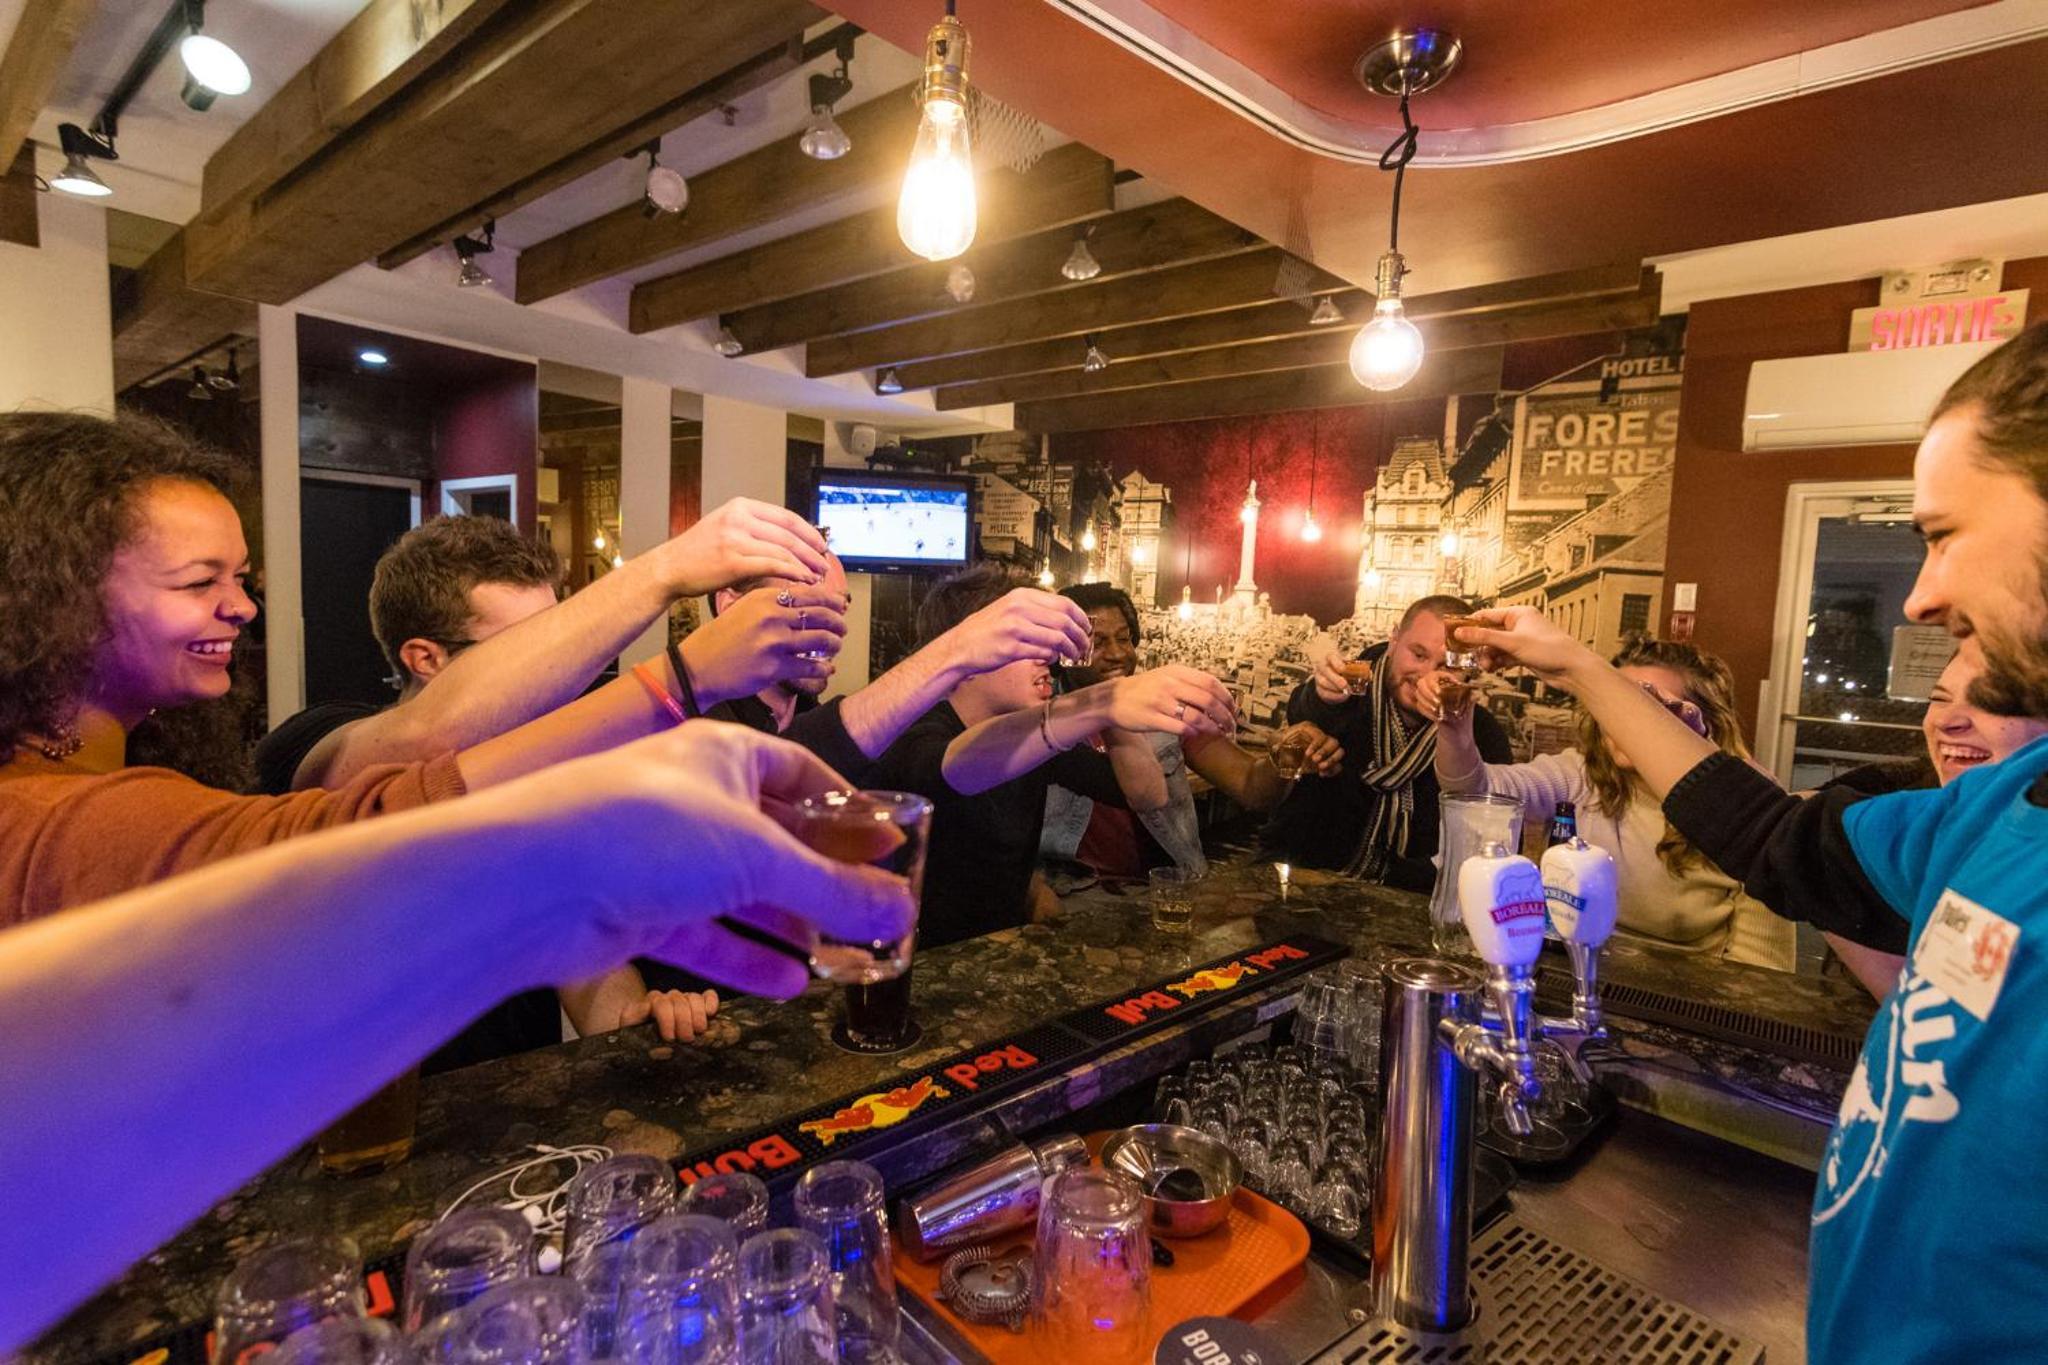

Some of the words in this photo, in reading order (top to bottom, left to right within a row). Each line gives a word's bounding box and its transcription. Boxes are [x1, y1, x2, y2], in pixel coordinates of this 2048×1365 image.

[1870, 297, 2007, 351] SORTIE
[1602, 356, 1674, 379] HOTEL
[1245, 944, 1310, 971] Red
[1104, 990, 1183, 1026] Bull
[943, 1044, 1038, 1090] Red
